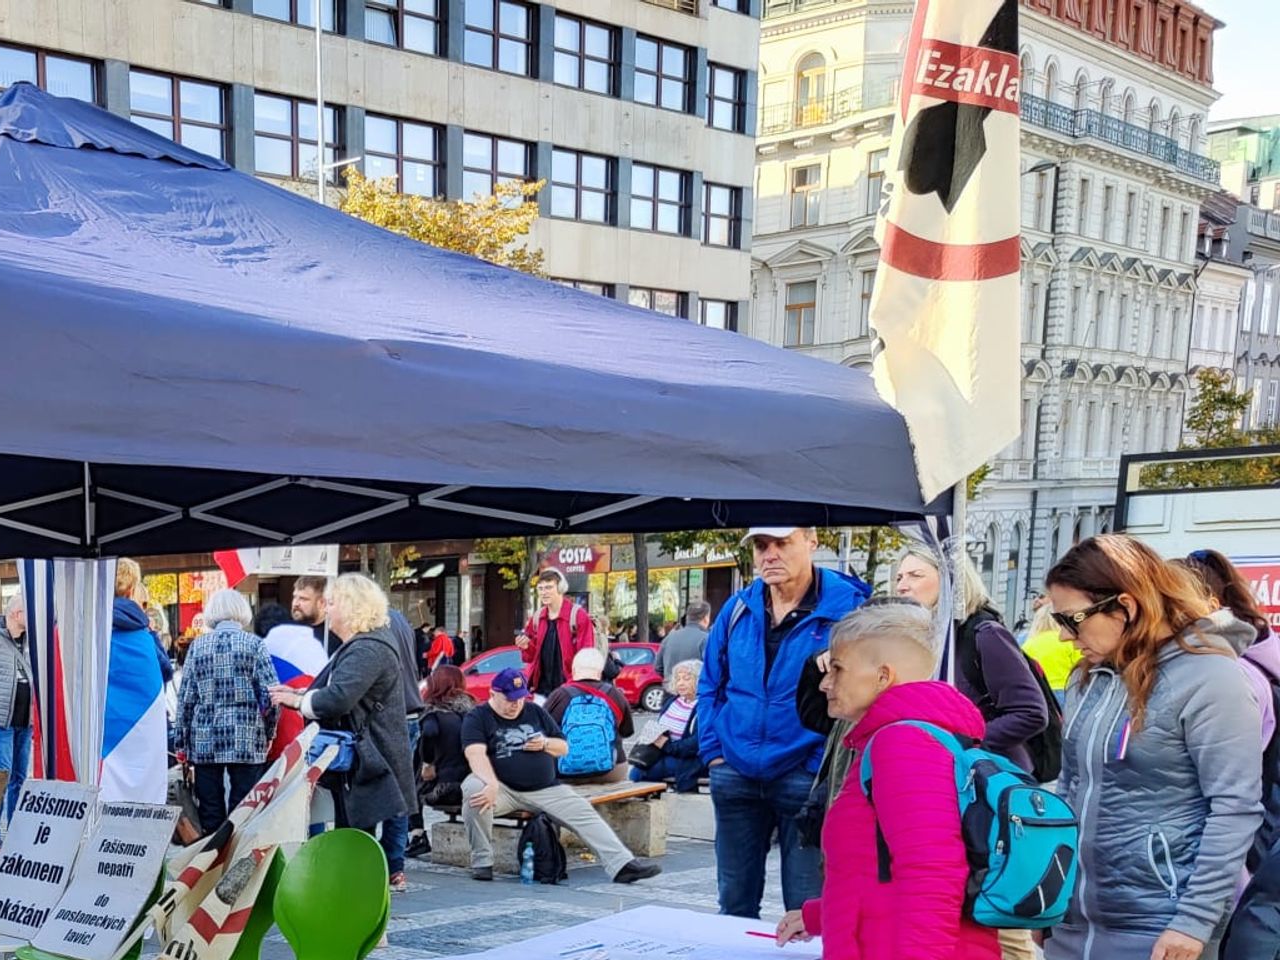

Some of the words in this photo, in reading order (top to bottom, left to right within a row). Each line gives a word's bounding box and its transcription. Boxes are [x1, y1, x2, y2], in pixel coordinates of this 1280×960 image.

[559, 547, 593, 564] COSTA
[19, 790, 88, 820] Fašismus
[33, 822, 51, 845] je
[98, 838, 148, 858] Fašismus
[97, 861, 135, 879] nepatří
[93, 893, 110, 908] do
[55, 908, 127, 931] poslaneckých
[62, 928, 96, 946] lavic!
